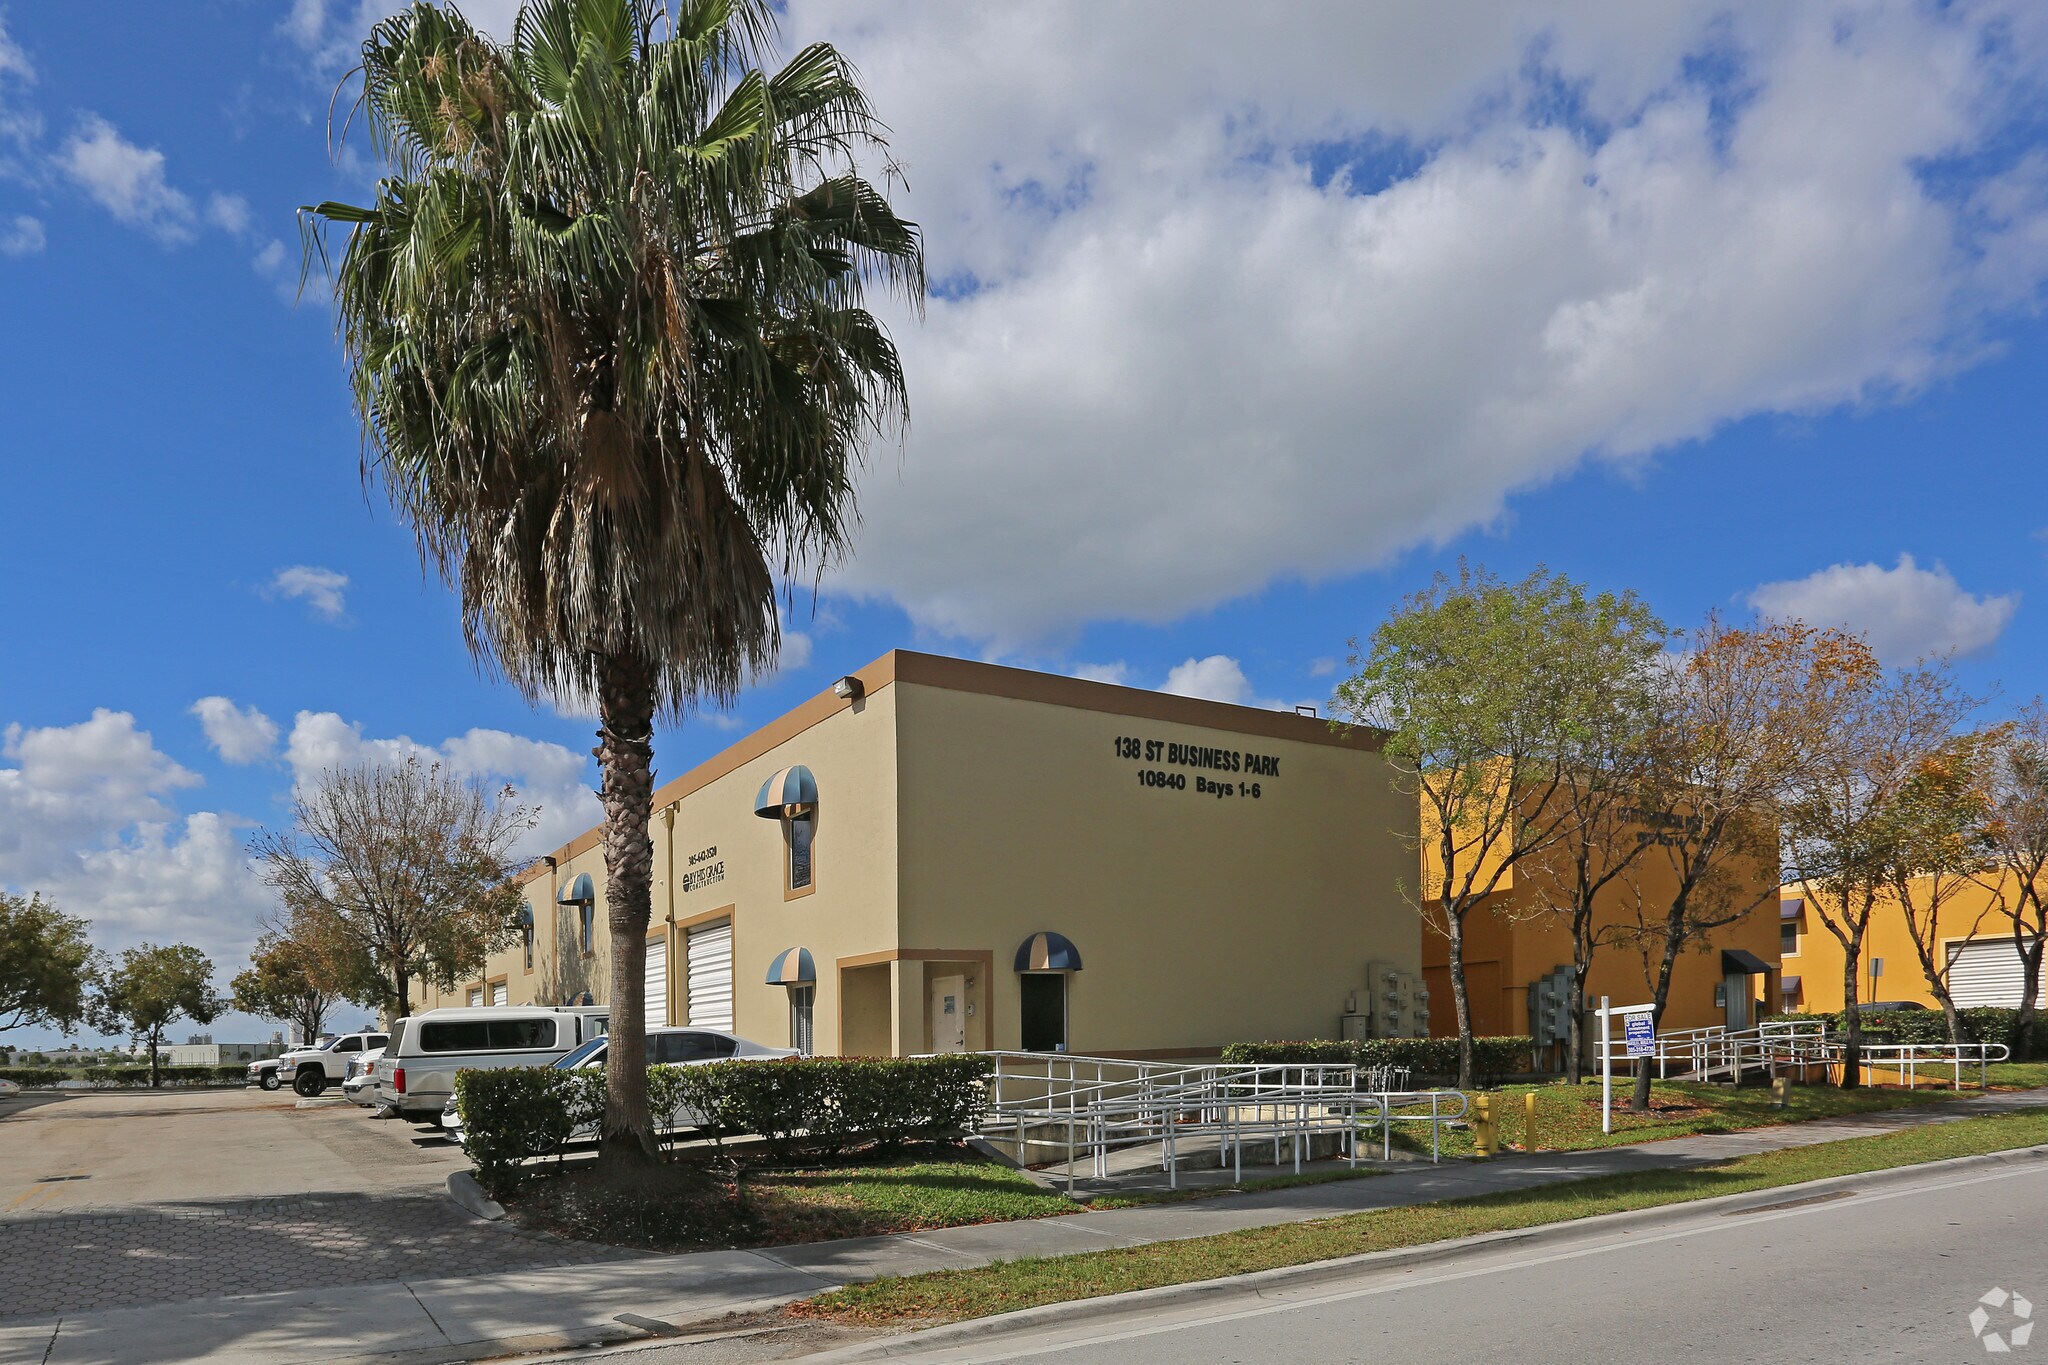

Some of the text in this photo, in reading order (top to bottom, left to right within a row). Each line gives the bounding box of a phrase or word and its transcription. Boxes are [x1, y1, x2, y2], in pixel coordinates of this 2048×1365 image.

[1114, 736, 1280, 777] 138 ST BUSINESS PARK
[1137, 769, 1261, 799] 10840 Bays 1-6
[706, 861, 724, 878] GRACE
[689, 874, 724, 891] CONSTRUCTION
